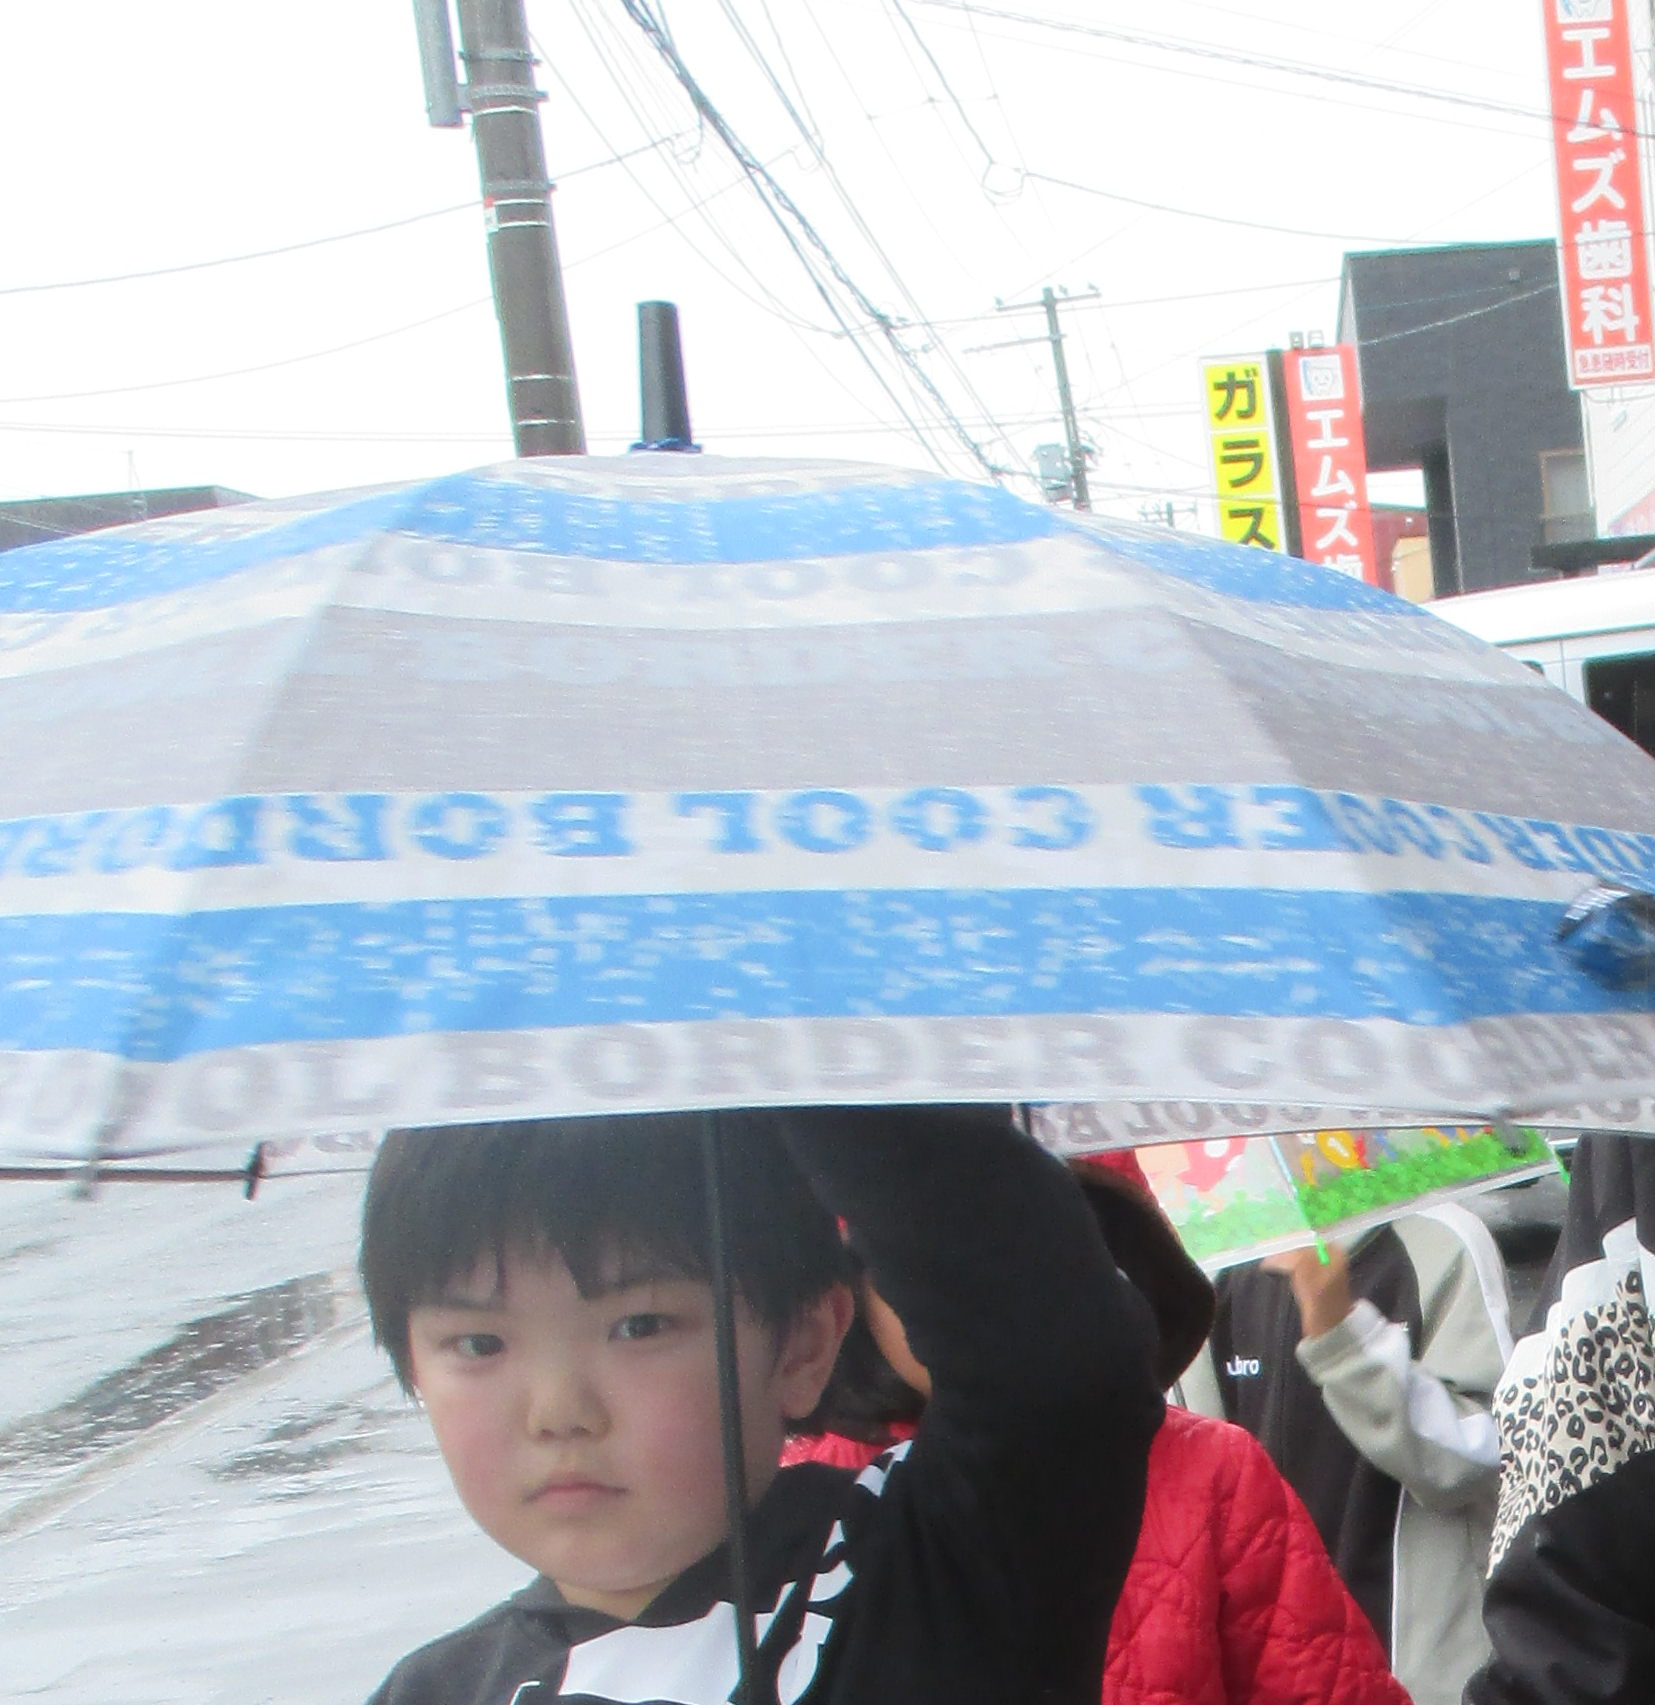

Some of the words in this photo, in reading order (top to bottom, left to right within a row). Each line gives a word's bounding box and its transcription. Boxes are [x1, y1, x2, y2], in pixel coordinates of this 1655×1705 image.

[1561, 27, 1641, 345] エムズ歯科
[1212, 368, 1275, 550] ガラス
[674, 785, 1094, 856] COOL
